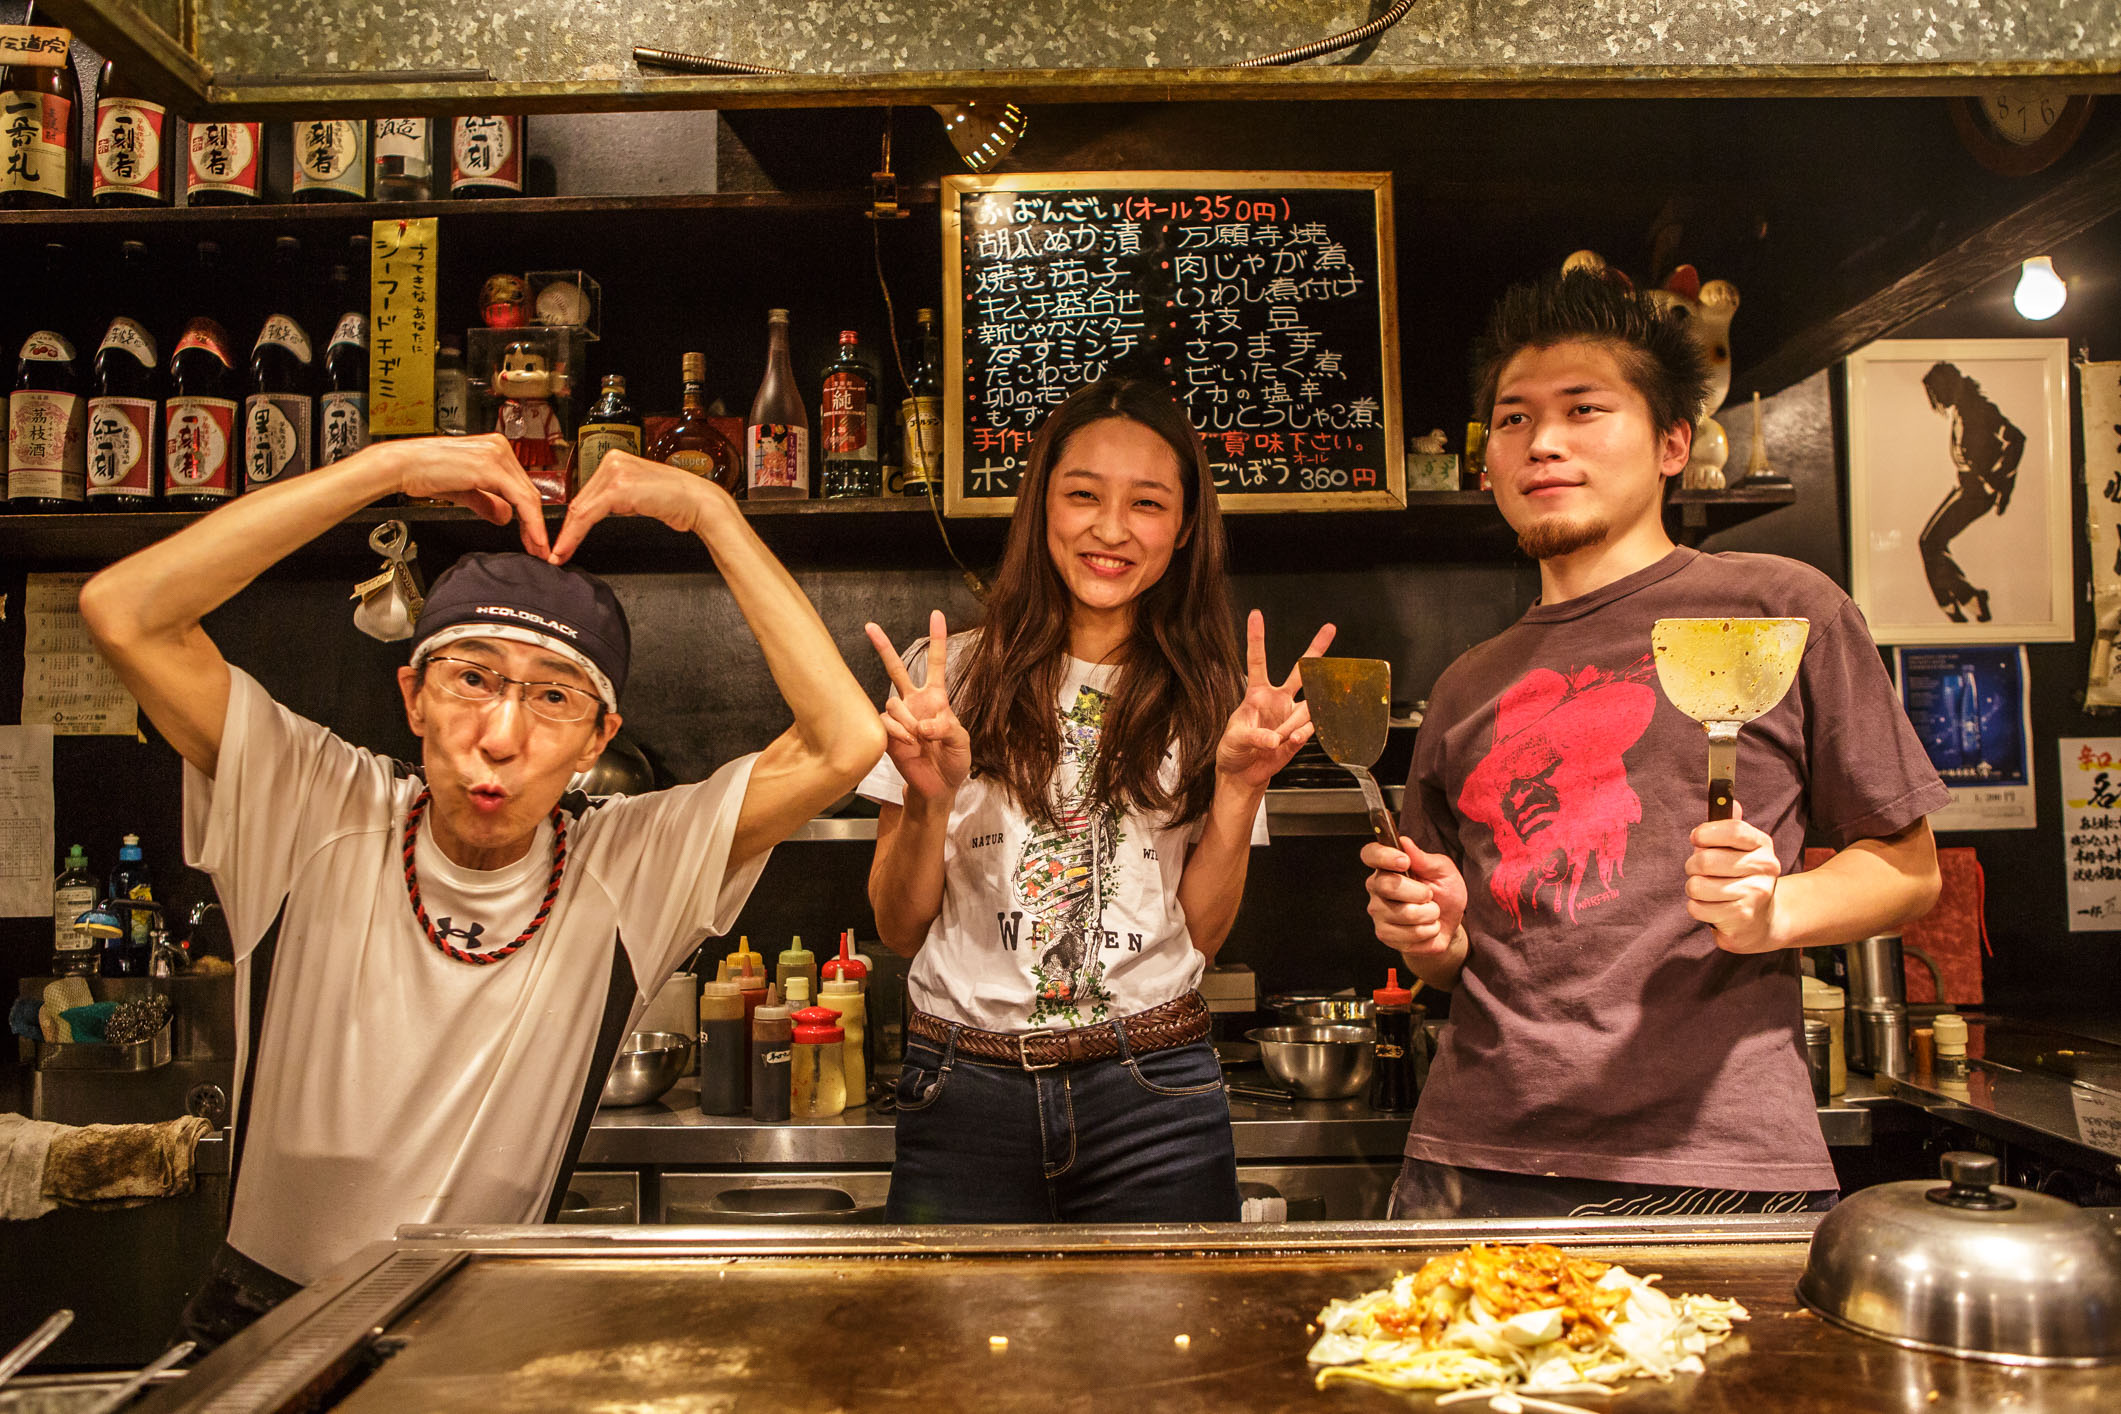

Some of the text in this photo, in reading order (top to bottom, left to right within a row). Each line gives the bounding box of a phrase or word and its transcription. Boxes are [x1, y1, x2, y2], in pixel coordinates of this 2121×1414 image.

[979, 219, 1142, 261] 胡瓜ぬか漬
[1178, 220, 1331, 248] 万願寺焼
[975, 258, 1131, 294] 焼き茄子
[1175, 272, 1364, 308] いわし煮付け
[410, 243, 428, 354] すてきなあなたに
[978, 287, 1144, 322] キムチ盛合せ
[978, 317, 1145, 344] 新じゃがバター
[987, 334, 1139, 364] なすミンチ
[1185, 331, 1323, 362] さつま芋
[985, 360, 1108, 387] たこわさび
[1185, 350, 1348, 385] ぜいたく煮
[833, 390, 854, 410] 純
[1183, 378, 1323, 405] イカの塩辛
[672, 455, 708, 468] Super
[972, 832, 1004, 849] NATUR
